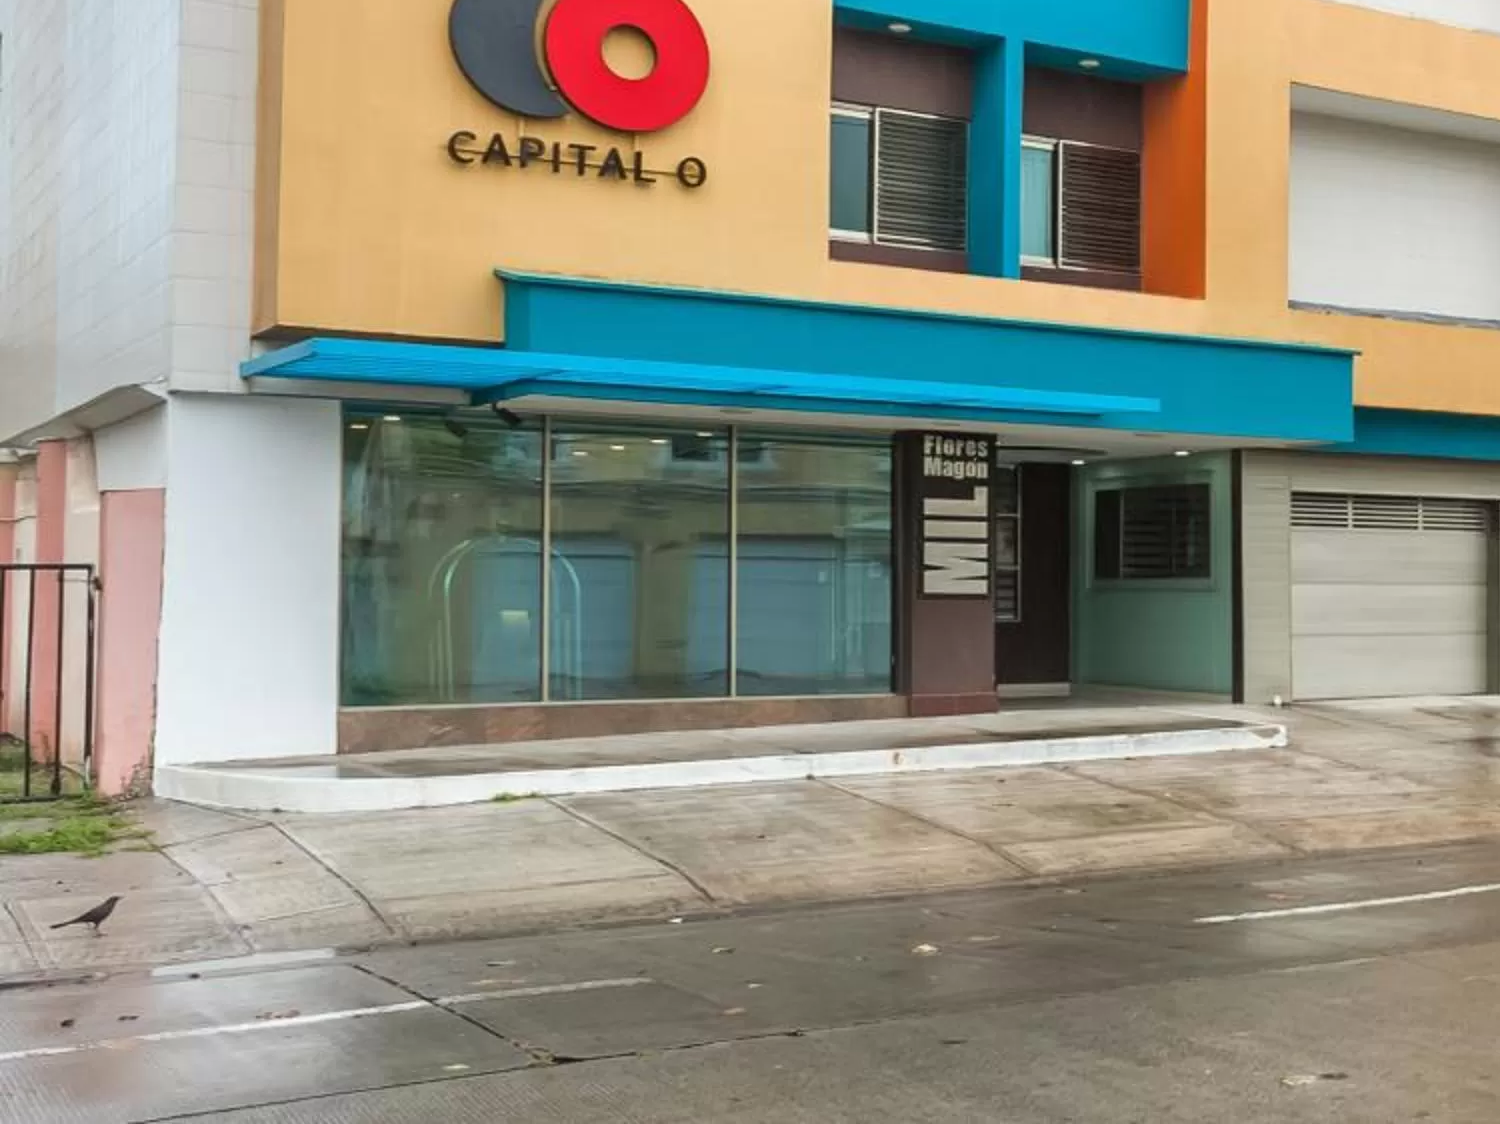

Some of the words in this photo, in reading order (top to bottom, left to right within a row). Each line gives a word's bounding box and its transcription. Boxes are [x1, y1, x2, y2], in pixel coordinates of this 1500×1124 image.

[448, 131, 656, 183] CAPITAL
[677, 157, 707, 188] O
[923, 435, 988, 457] Flores
[923, 456, 988, 479] Magón
[923, 486, 988, 594] MIL
